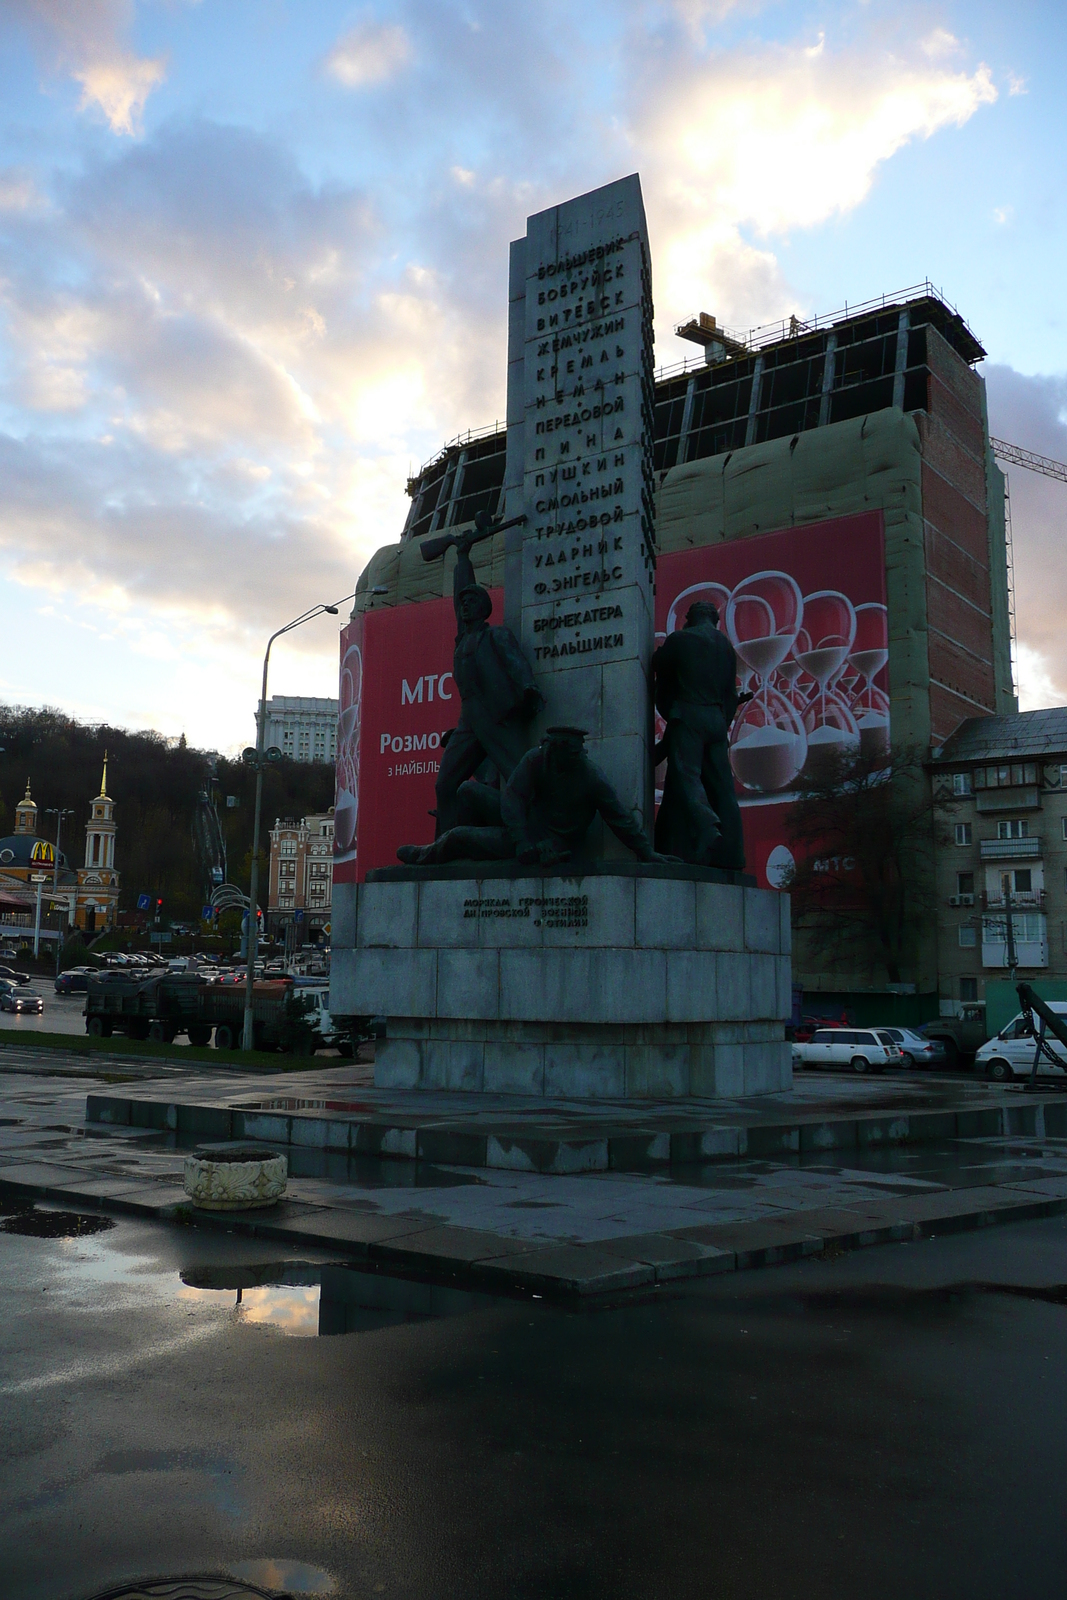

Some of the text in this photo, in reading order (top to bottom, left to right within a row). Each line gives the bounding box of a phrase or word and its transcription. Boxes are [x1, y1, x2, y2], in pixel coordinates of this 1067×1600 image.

[537, 237, 624, 280] БОЛЬШЕВИК
[537, 264, 624, 305] БОБРУЙСК
[537, 290, 624, 331] ВИТЕБСК
[537, 317, 624, 357] ЖЕМЧУЖИН
[536, 345, 624, 382] КРЕМЛЬ
[536, 371, 624, 409] НЕМАН
[535, 396, 624, 435] ПЕРЕДОВОЙ
[535, 426, 624, 461] ПИНА
[535, 453, 624, 487] ПУШКИН
[535, 478, 624, 513] СМОЛЬНЫЙ
[535, 506, 624, 541] ТРУДОВОЙ
[535, 537, 623, 568] УДАРНИК
[534, 566, 623, 595] Ф.ЭНГЕЛЬС
[533, 604, 623, 633] БРОНЕКАТЕРА
[534, 633, 624, 660] ТРАЛЬЩИКИ
[401, 672, 453, 705] МТС
[463, 898, 510, 907] МОРЯКАМ
[463, 906, 530, 918] ДНПРОВСКОЙ
[533, 919, 588, 928] ФОТИЛИИ
